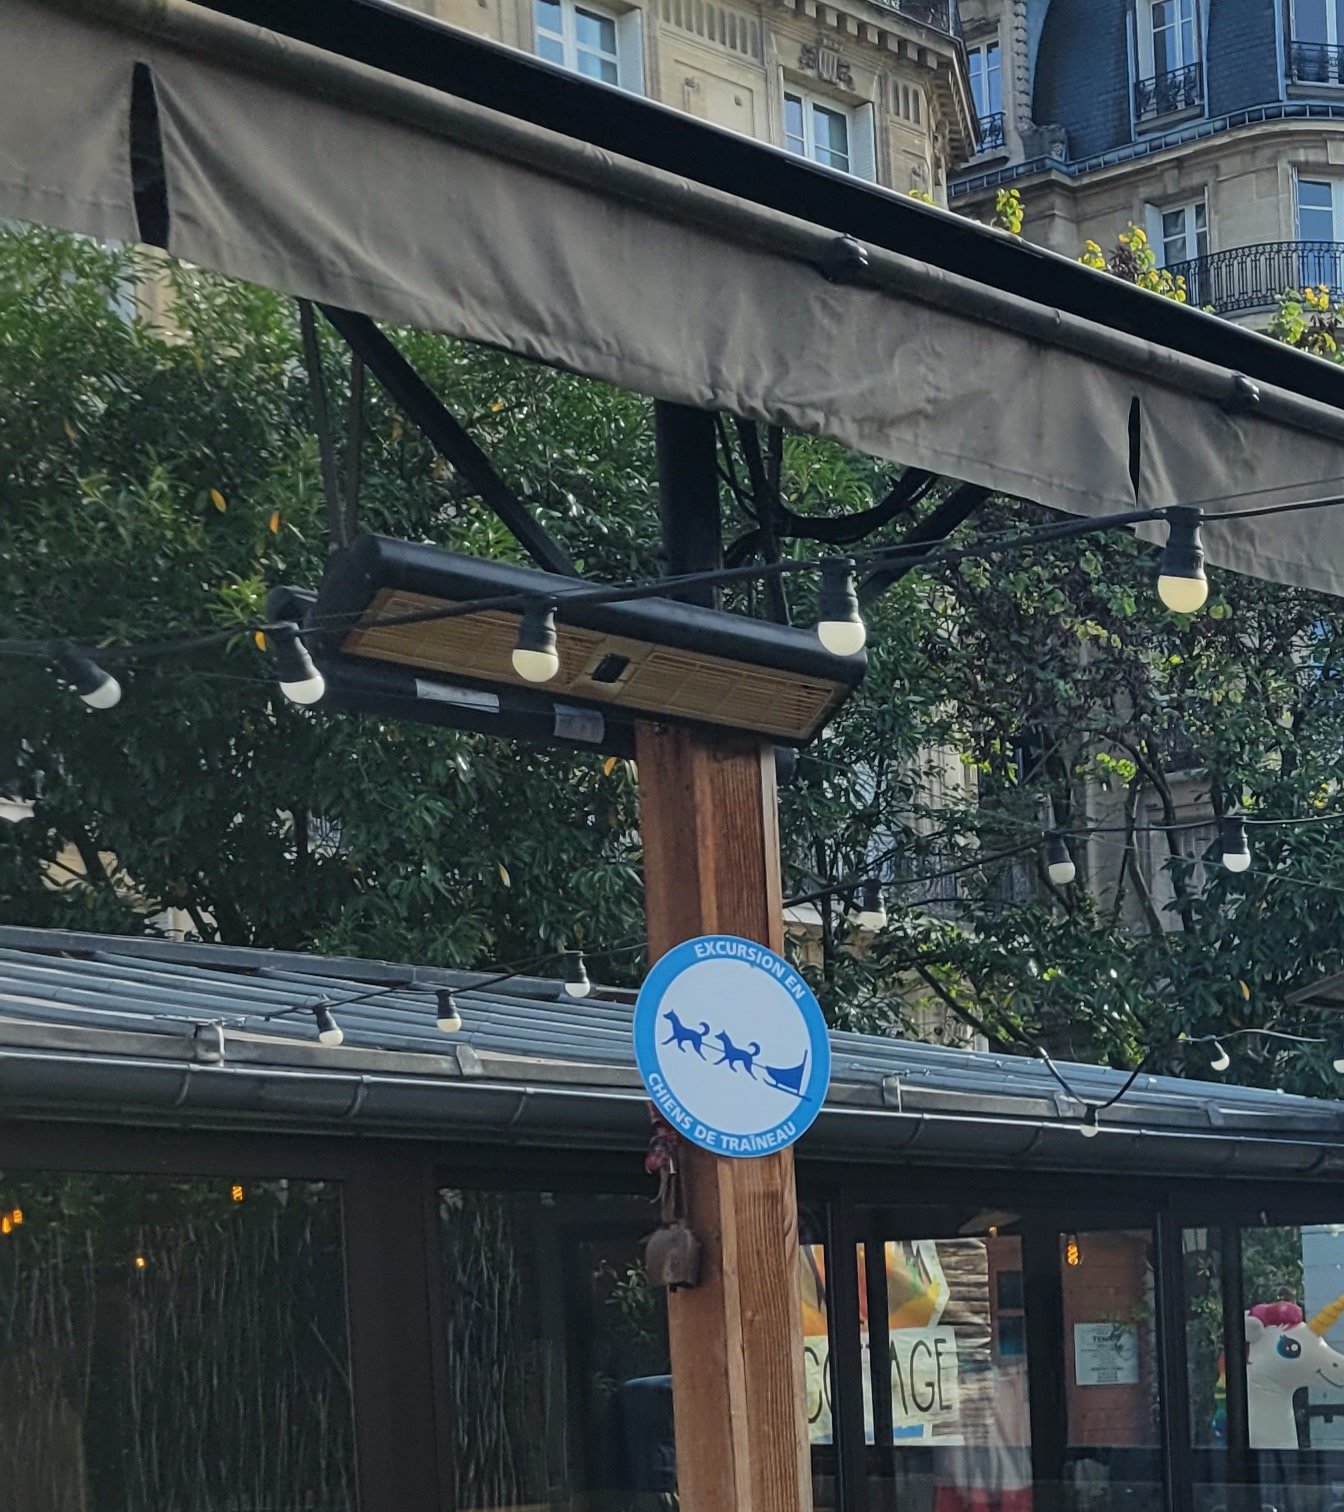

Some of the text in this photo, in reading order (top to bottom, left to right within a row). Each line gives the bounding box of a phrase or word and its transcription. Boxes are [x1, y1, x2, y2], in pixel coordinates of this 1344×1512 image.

[694, 940, 806, 1000] EXCURSION EN
[648, 1072, 797, 1152] CHIENS DE TRAÎNEAU
